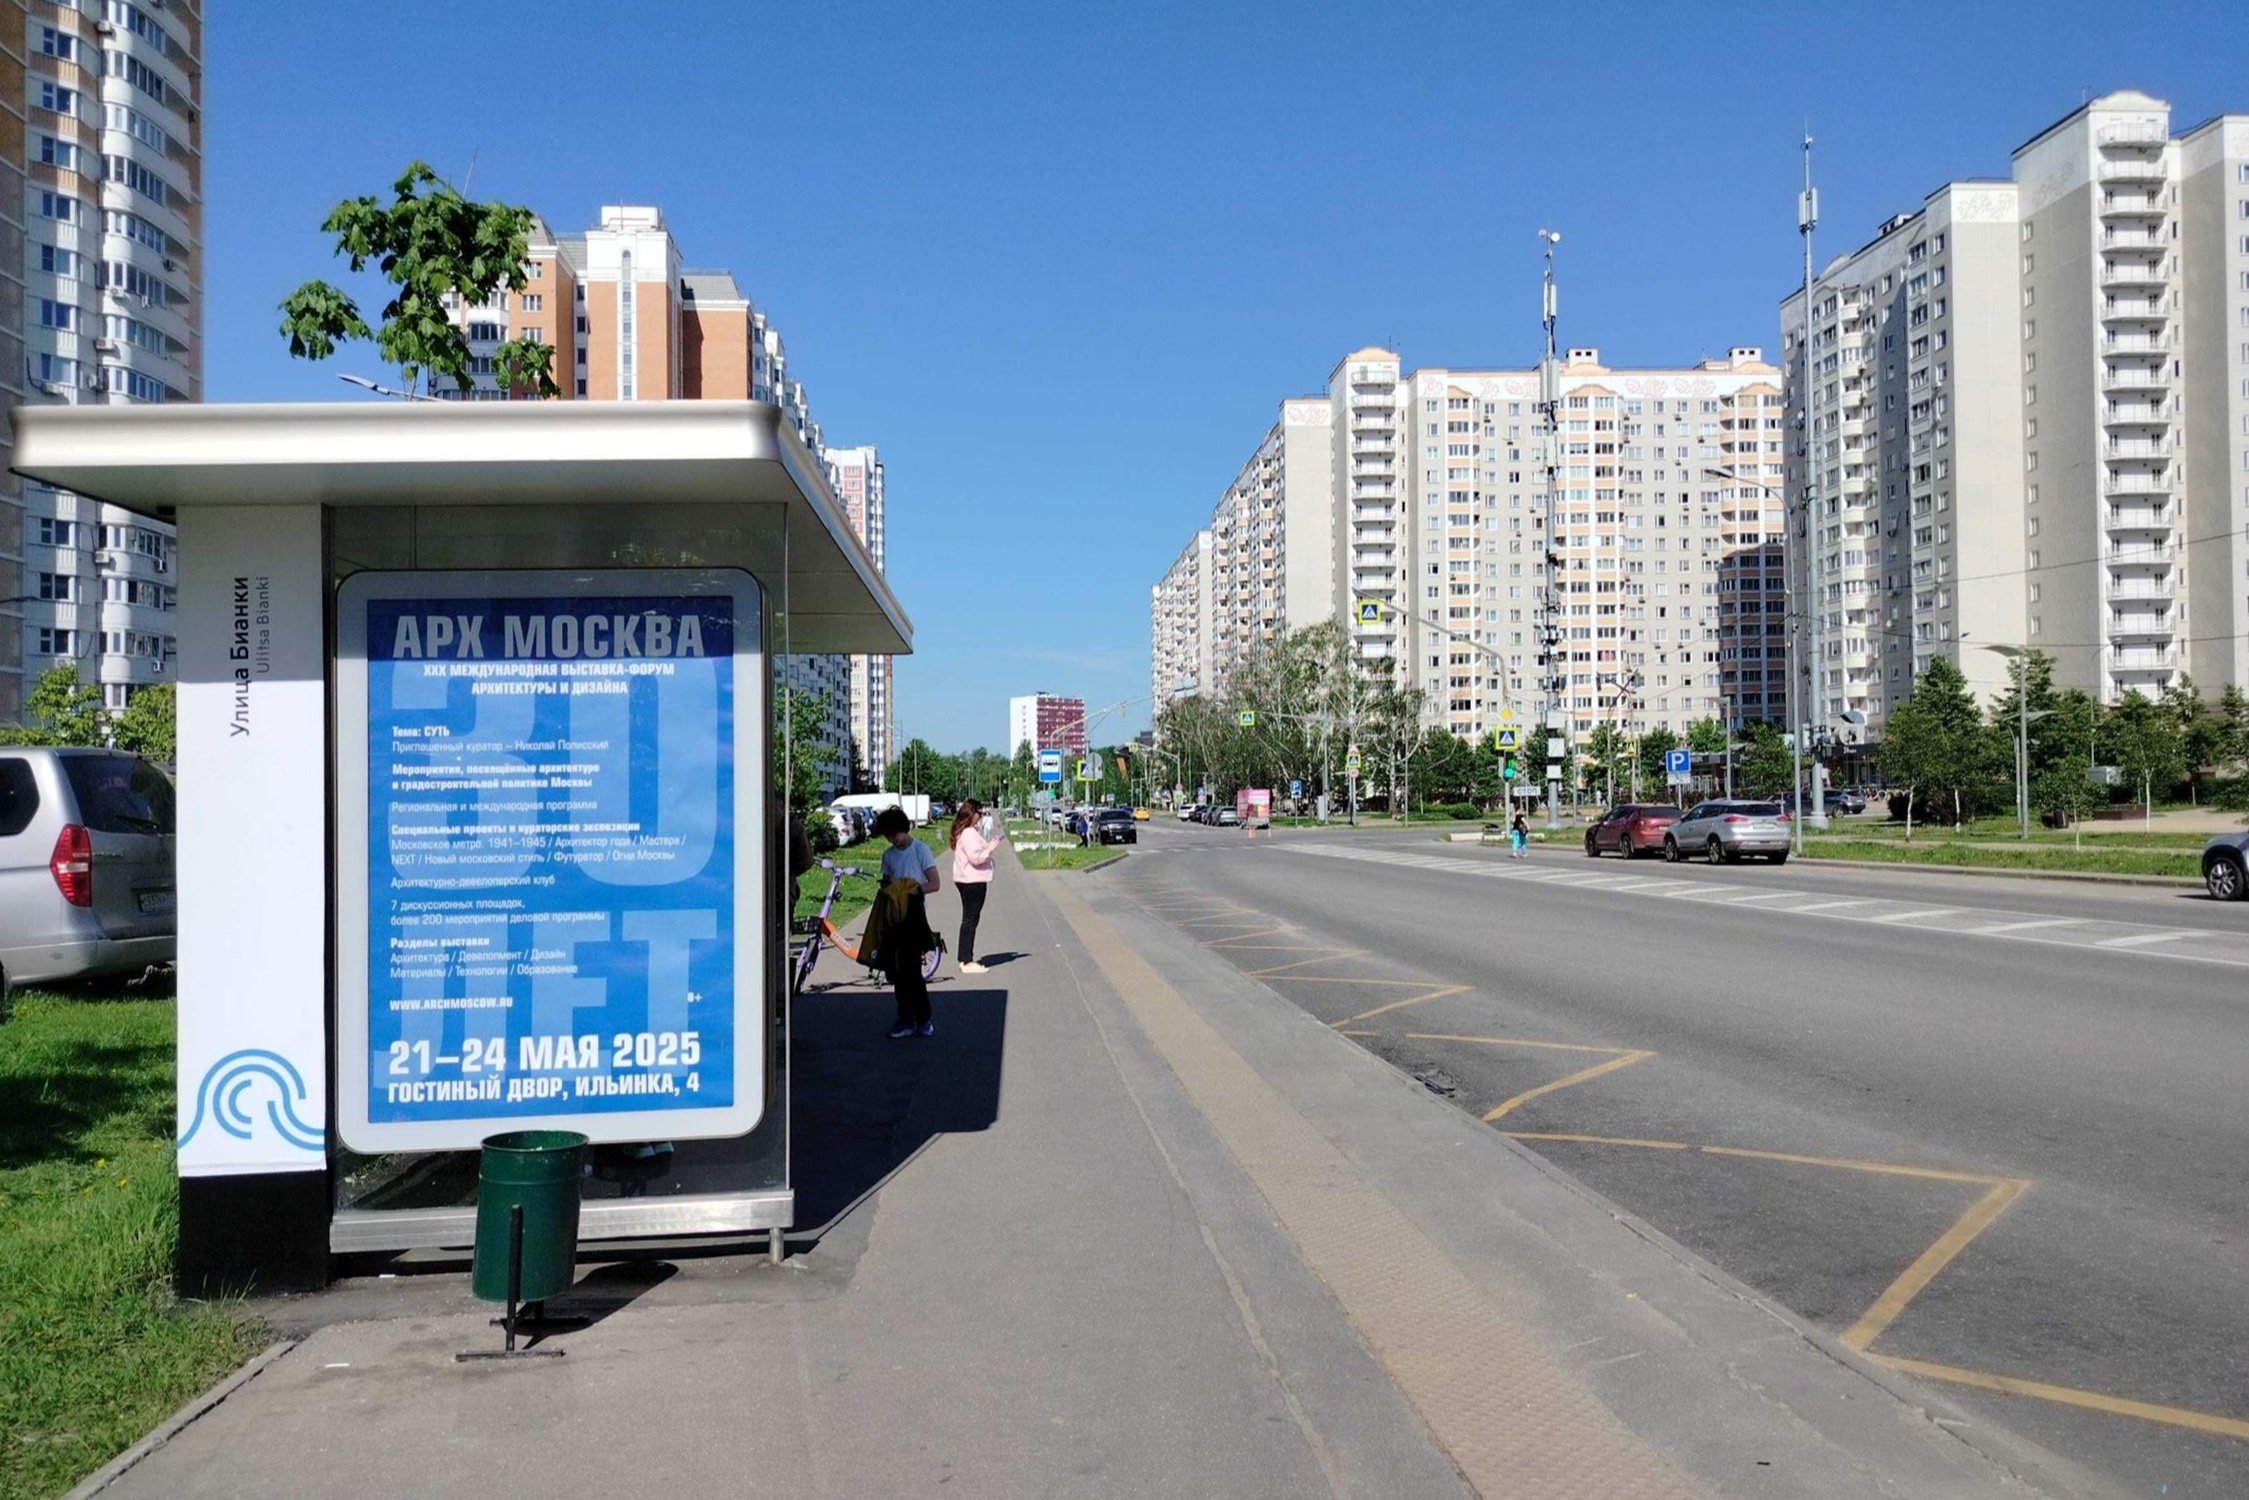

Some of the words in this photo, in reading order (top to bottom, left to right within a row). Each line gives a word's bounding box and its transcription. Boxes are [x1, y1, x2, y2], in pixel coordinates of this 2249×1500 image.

[256, 576, 269, 625] Bianki
[230, 577, 249, 660] Бианки
[392, 615, 484, 658] АРХ
[504, 614, 705, 658] МОСКВА
[256, 629, 270, 673] Ulitsa
[450, 663, 557, 680] МЕЖДУНАРОДНАЯ
[561, 663, 675, 677] ВЫСТАВКА-ФОРУМ
[471, 682, 557, 695] АРХИТЕКТУРЫ
[559, 682, 569, 694] И
[572, 680, 628, 696] ДИЗАЙНА
[230, 668, 251, 737] Улица
[392, 726, 421, 737] Тема:
[424, 726, 450, 737] СУТЬ
[466, 742, 503, 753] куратор
[515, 740, 555, 750] Николай
[392, 764, 464, 776] Мероприятия,
[539, 764, 600, 775] архитектуре
[401, 779, 499, 791] градостроительной
[502, 778, 548, 788] политике
[551, 777, 592, 788] Москвы
[391, 802, 457, 813] Региональная
[460, 803, 467, 811] и
[469, 801, 544, 813] международная
[547, 800, 597, 812] программа
[391, 825, 461, 836] Специальные
[464, 824, 507, 835] проекты
[509, 824, 516, 833] и
[518, 823, 580, 835] кураторские
[582, 822, 640, 833] экспозиции
[391, 839, 450, 850] Московское
[452, 839, 484, 851] метро.
[555, 836, 607, 848] Архитектор
[610, 836, 631, 847] года
[639, 835, 680, 846] Мастера
[391, 855, 415, 865] NEXT
[424, 854, 456, 864] Новый
[458, 853, 515, 863] московский
[517, 853, 545, 863] стиль
[554, 850, 604, 863] Футуратор
[612, 850, 635, 861] Огни
[637, 850, 675, 861] Москвы
[390, 876, 531, 889] Архитектурно-девелоперский
[533, 875, 555, 887] клуб
[391, 900, 398, 910] 7
[400, 900, 473, 911] дискуссионных
[391, 914, 419, 925] более
[422, 914, 442, 925] 200
[445, 914, 508, 925] мероприятий
[510, 912, 549, 923] деловой
[552, 912, 605, 924] программы
[391, 937, 438, 948] Разделы
[440, 937, 489, 947] выставки
[390, 953, 450, 964] Архитектура
[457, 951, 522, 963] Девелопмент
[530, 949, 566, 961] Дизайн
[390, 967, 446, 978] Материалы
[455, 965, 508, 977] Технологии
[517, 964, 578, 975] Образование
[389, 997, 514, 1011] WWW.ARCHMOSCOW.RU
[519, 1035, 599, 1072] МАЯ
[612, 1032, 701, 1069] 2025
[388, 1075, 501, 1103] ГОСТИНЫЙ
[507, 1077, 568, 1102] ДВОР,
[575, 1072, 680, 1098] ИЛЬИНКА,
[685, 1072, 700, 1092] 4
